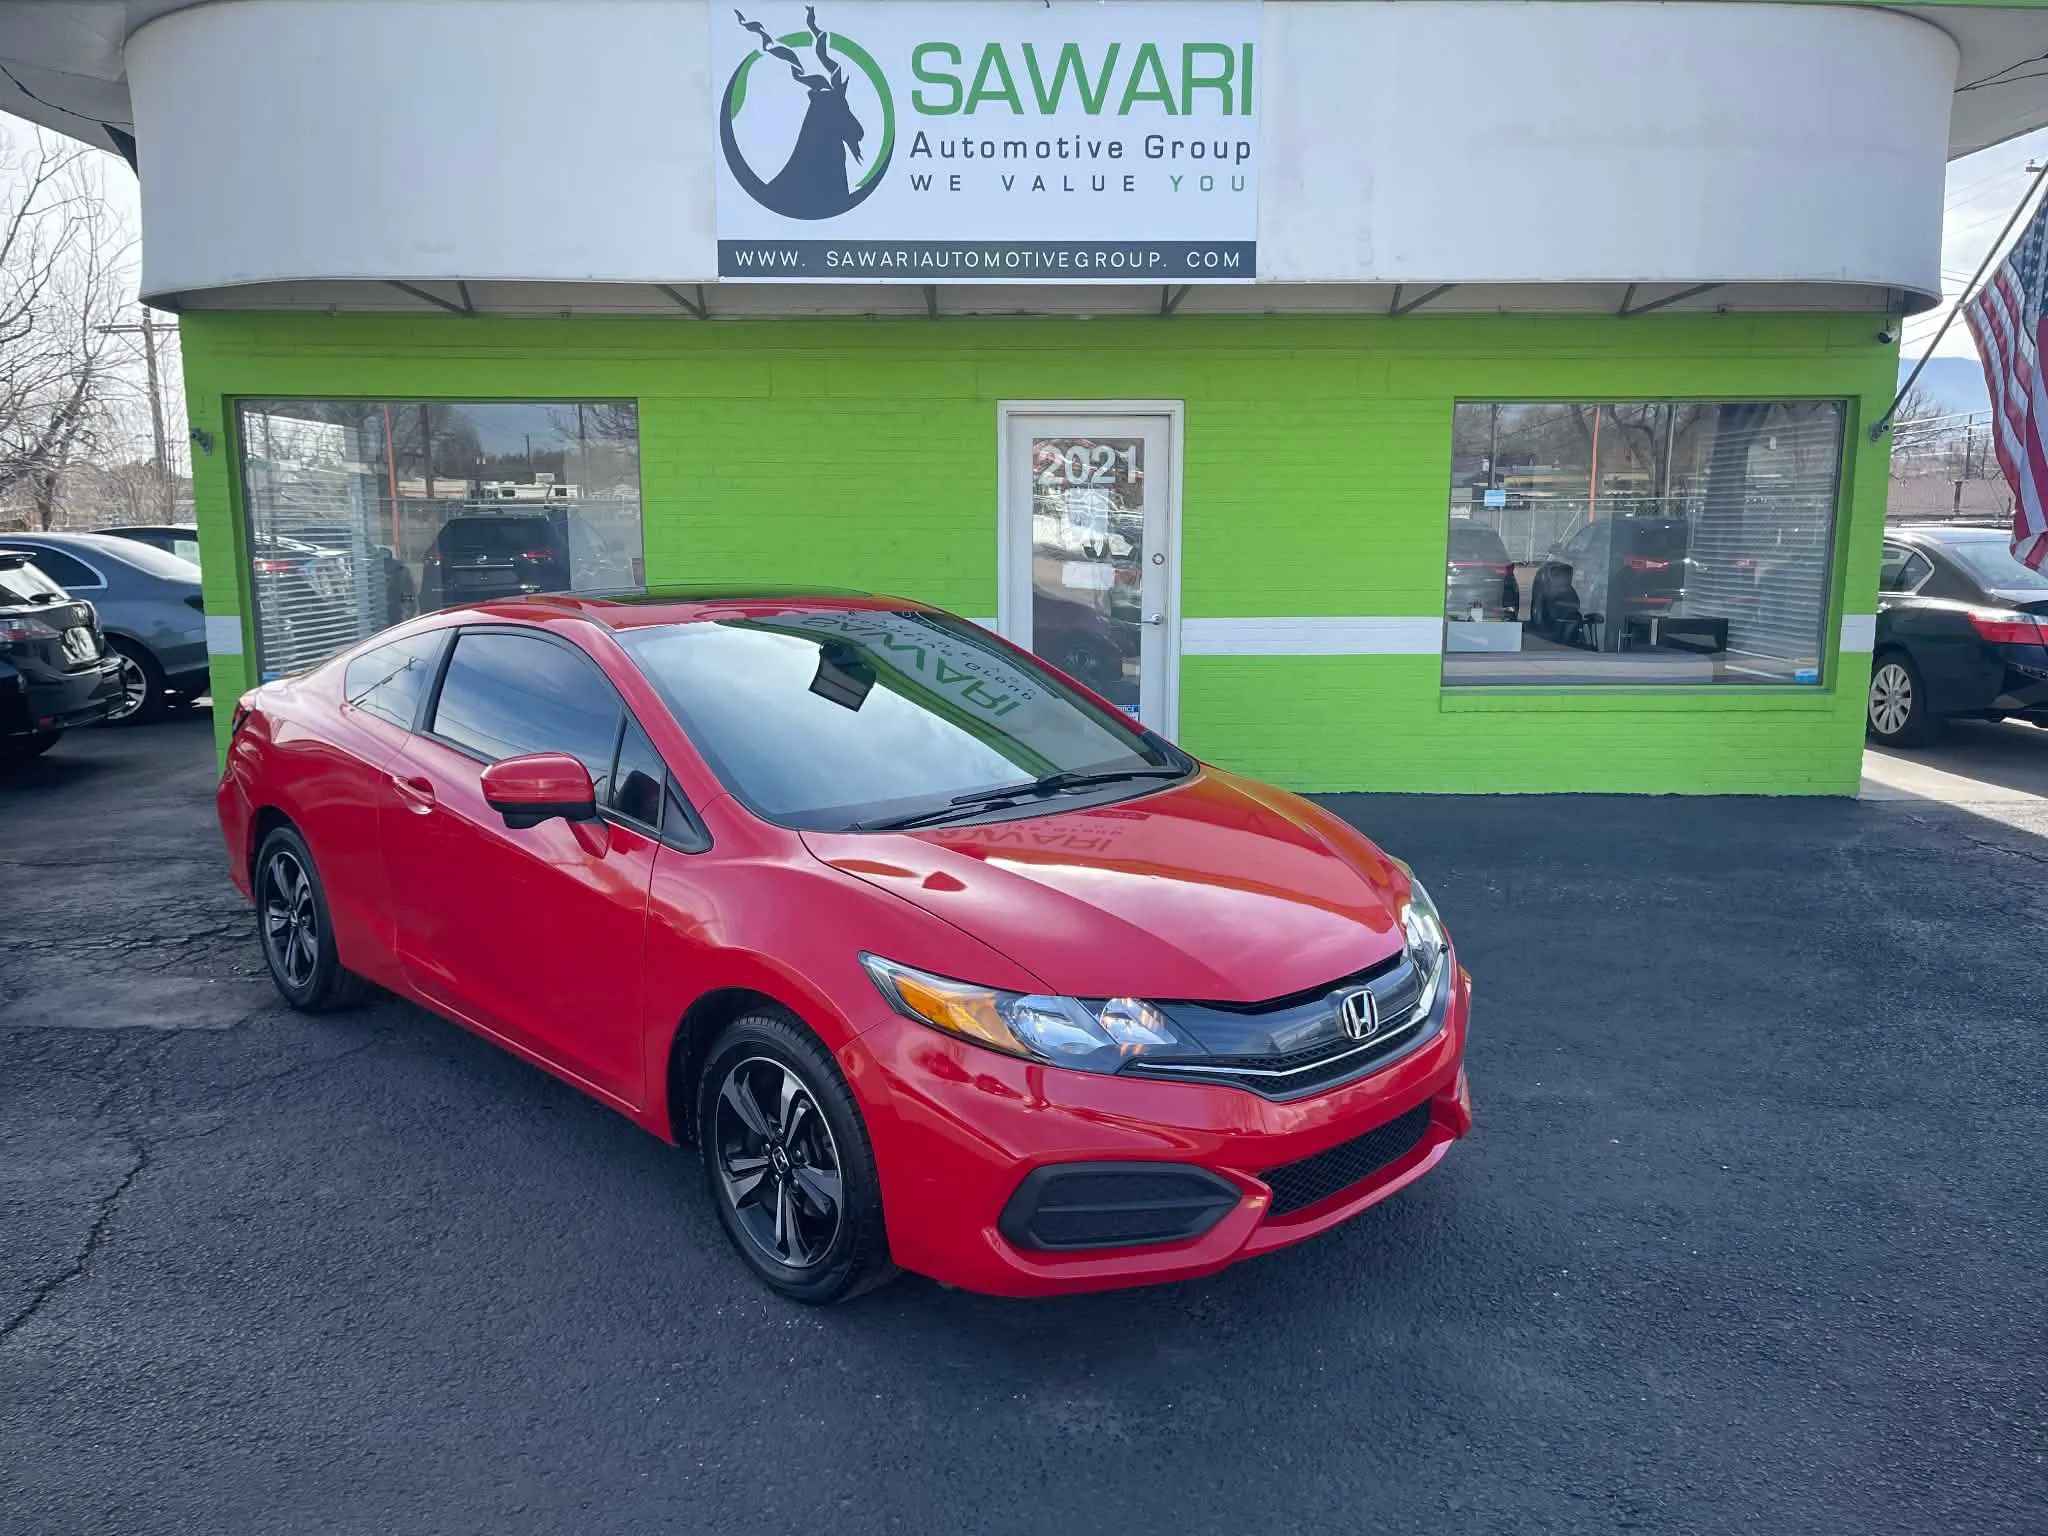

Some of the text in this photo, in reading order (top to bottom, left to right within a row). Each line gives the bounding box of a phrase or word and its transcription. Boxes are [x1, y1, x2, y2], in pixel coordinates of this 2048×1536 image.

[912, 42, 1254, 116] SAWARI
[910, 131, 1251, 165] Automotive Group
[910, 174, 1246, 193] WE VALUE YOU
[1186, 250, 1239, 268] COM
[1038, 445, 1136, 484] 2021
